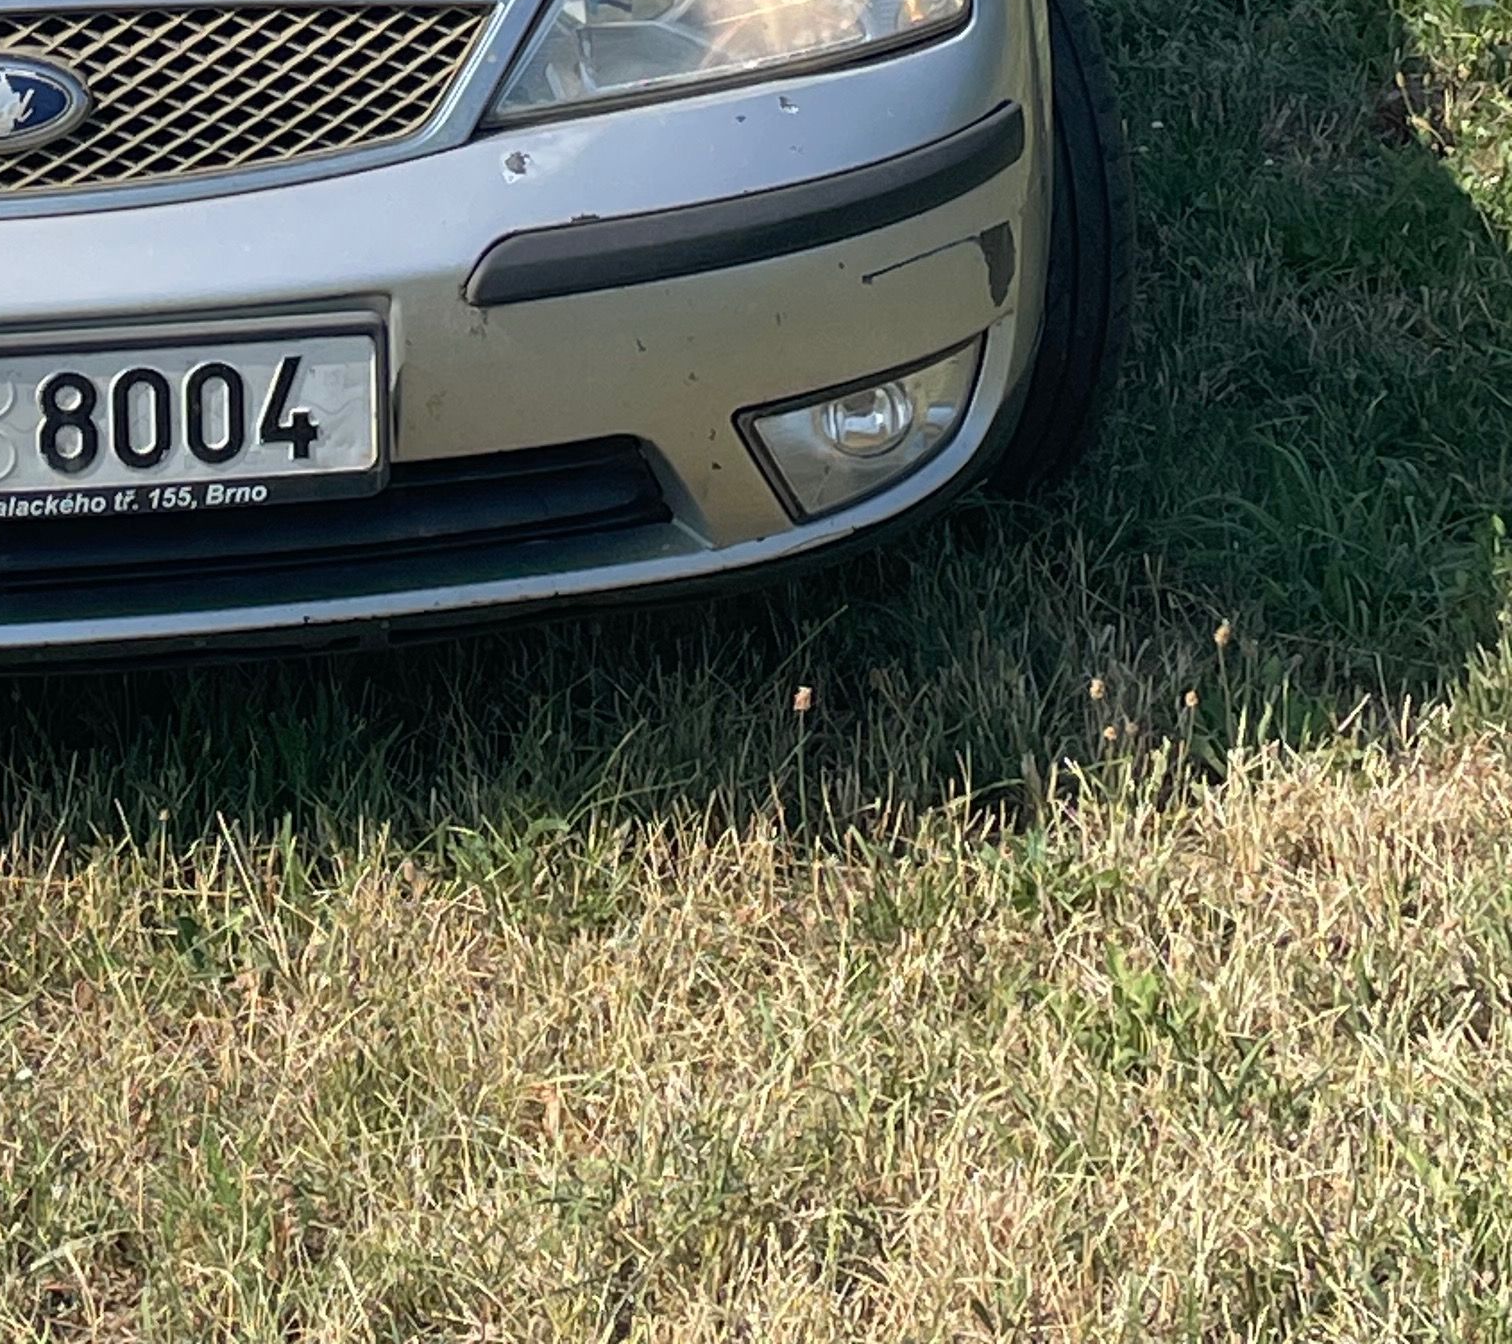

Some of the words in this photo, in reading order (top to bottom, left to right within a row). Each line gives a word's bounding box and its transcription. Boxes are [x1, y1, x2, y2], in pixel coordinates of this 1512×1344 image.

[39, 355, 319, 474] 8004
[114, 488, 139, 511] tř.
[148, 483, 198, 510] 155,
[205, 482, 268, 506] Brno
